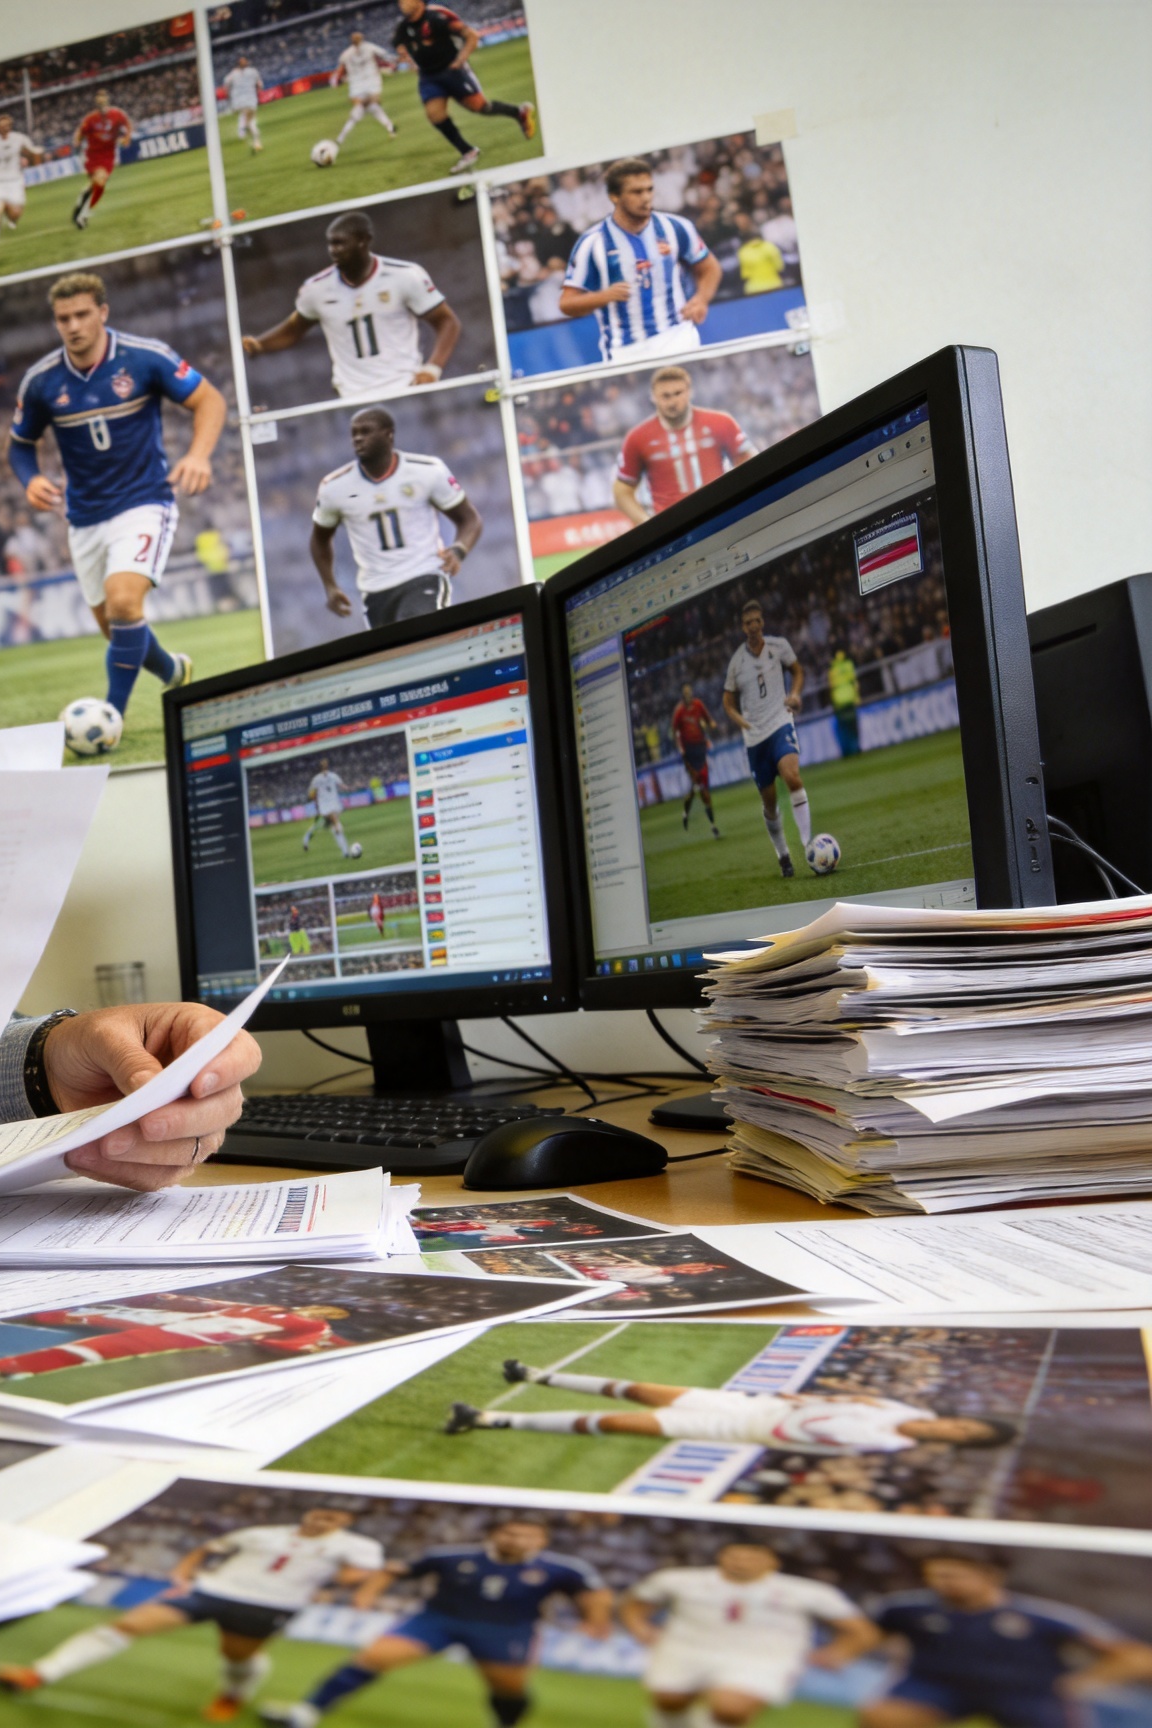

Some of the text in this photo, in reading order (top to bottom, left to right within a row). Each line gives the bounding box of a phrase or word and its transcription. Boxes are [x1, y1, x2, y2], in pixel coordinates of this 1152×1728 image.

[346, 313, 380, 359] 11
[134, 534, 153, 562] 2
[368, 507, 405, 551] 11
